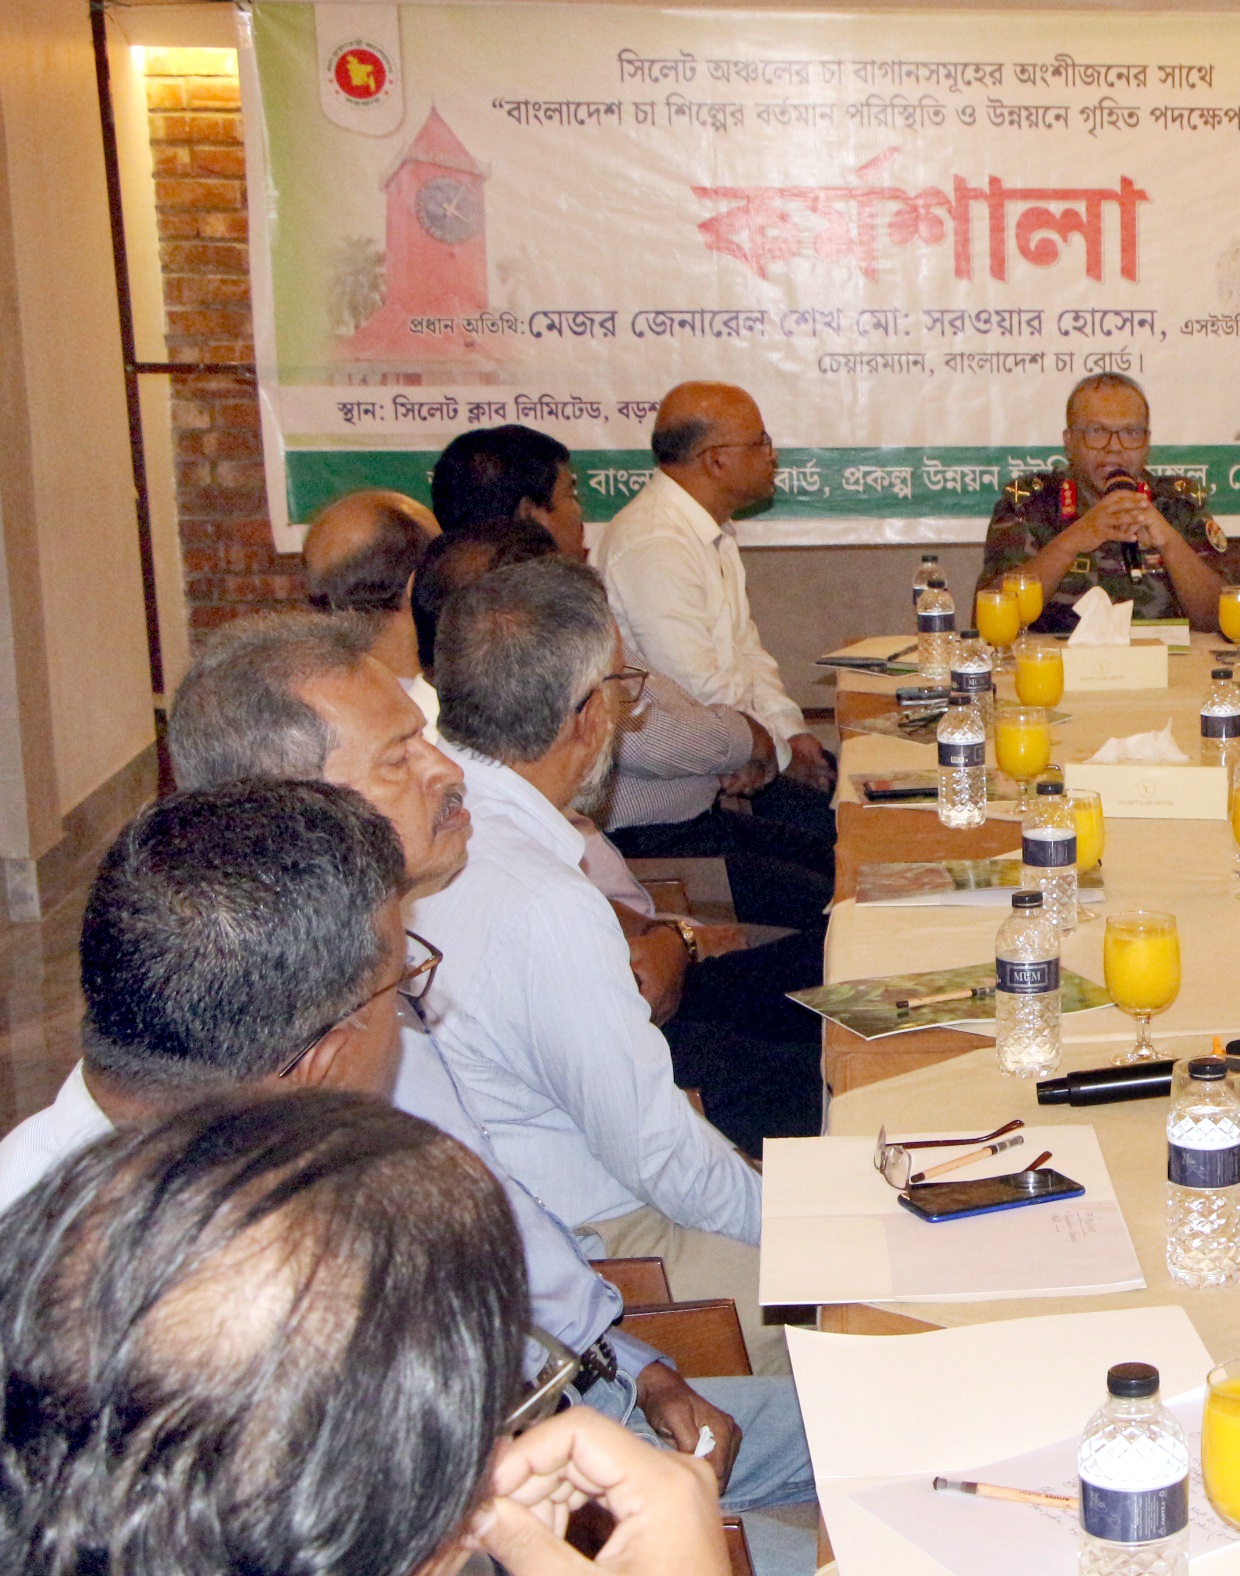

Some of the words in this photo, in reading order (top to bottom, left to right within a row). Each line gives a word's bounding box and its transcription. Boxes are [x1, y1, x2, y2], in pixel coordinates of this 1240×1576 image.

[618, 49, 697, 85] সিলেট
[706, 58, 810, 85] অঞ্চলের
[820, 59, 843, 85] চা
[852, 60, 1004, 93] বাগানসমূহের
[1013, 53, 1149, 90] অংশীজনের
[1158, 63, 1214, 90] সাথে
[632, 102, 656, 127] চা
[665, 92, 744, 133] শিল্পের
[755, 97, 836, 127] বর্তমান
[846, 94, 946, 132] পরিস্থিতি
[955, 106, 976, 128] ও
[986, 98, 1070, 131] উন্নয়নে
[1080, 97, 1141, 137] গৃহিত
[690, 145, 1151, 283] কর্মশালা
[409, 318, 455, 336] প্রধান
[462, 312, 525, 335] অতিথি:
[528, 310, 618, 339] মেজর
[631, 309, 768, 339] জেনারেল
[780, 309, 843, 338] শেখ
[921, 309, 1045, 338] সরওয়ার
[1057, 309, 1168, 342] হোসেন,
[817, 352, 936, 377] চেয়ারম্যান,
[944, 352, 1045, 375] বাংলাদেশ
[1054, 353, 1075, 374] চা
[337, 401, 385, 425] স্থান:
[393, 394, 459, 422] সিলেট
[466, 401, 507, 424] ক্লাব
[515, 394, 609, 424] লিমিটেড,
[842, 464, 913, 499] প্রকল্প
[921, 457, 999, 495] উন্নয়ন
[1013, 971, 1041, 982] MUM
